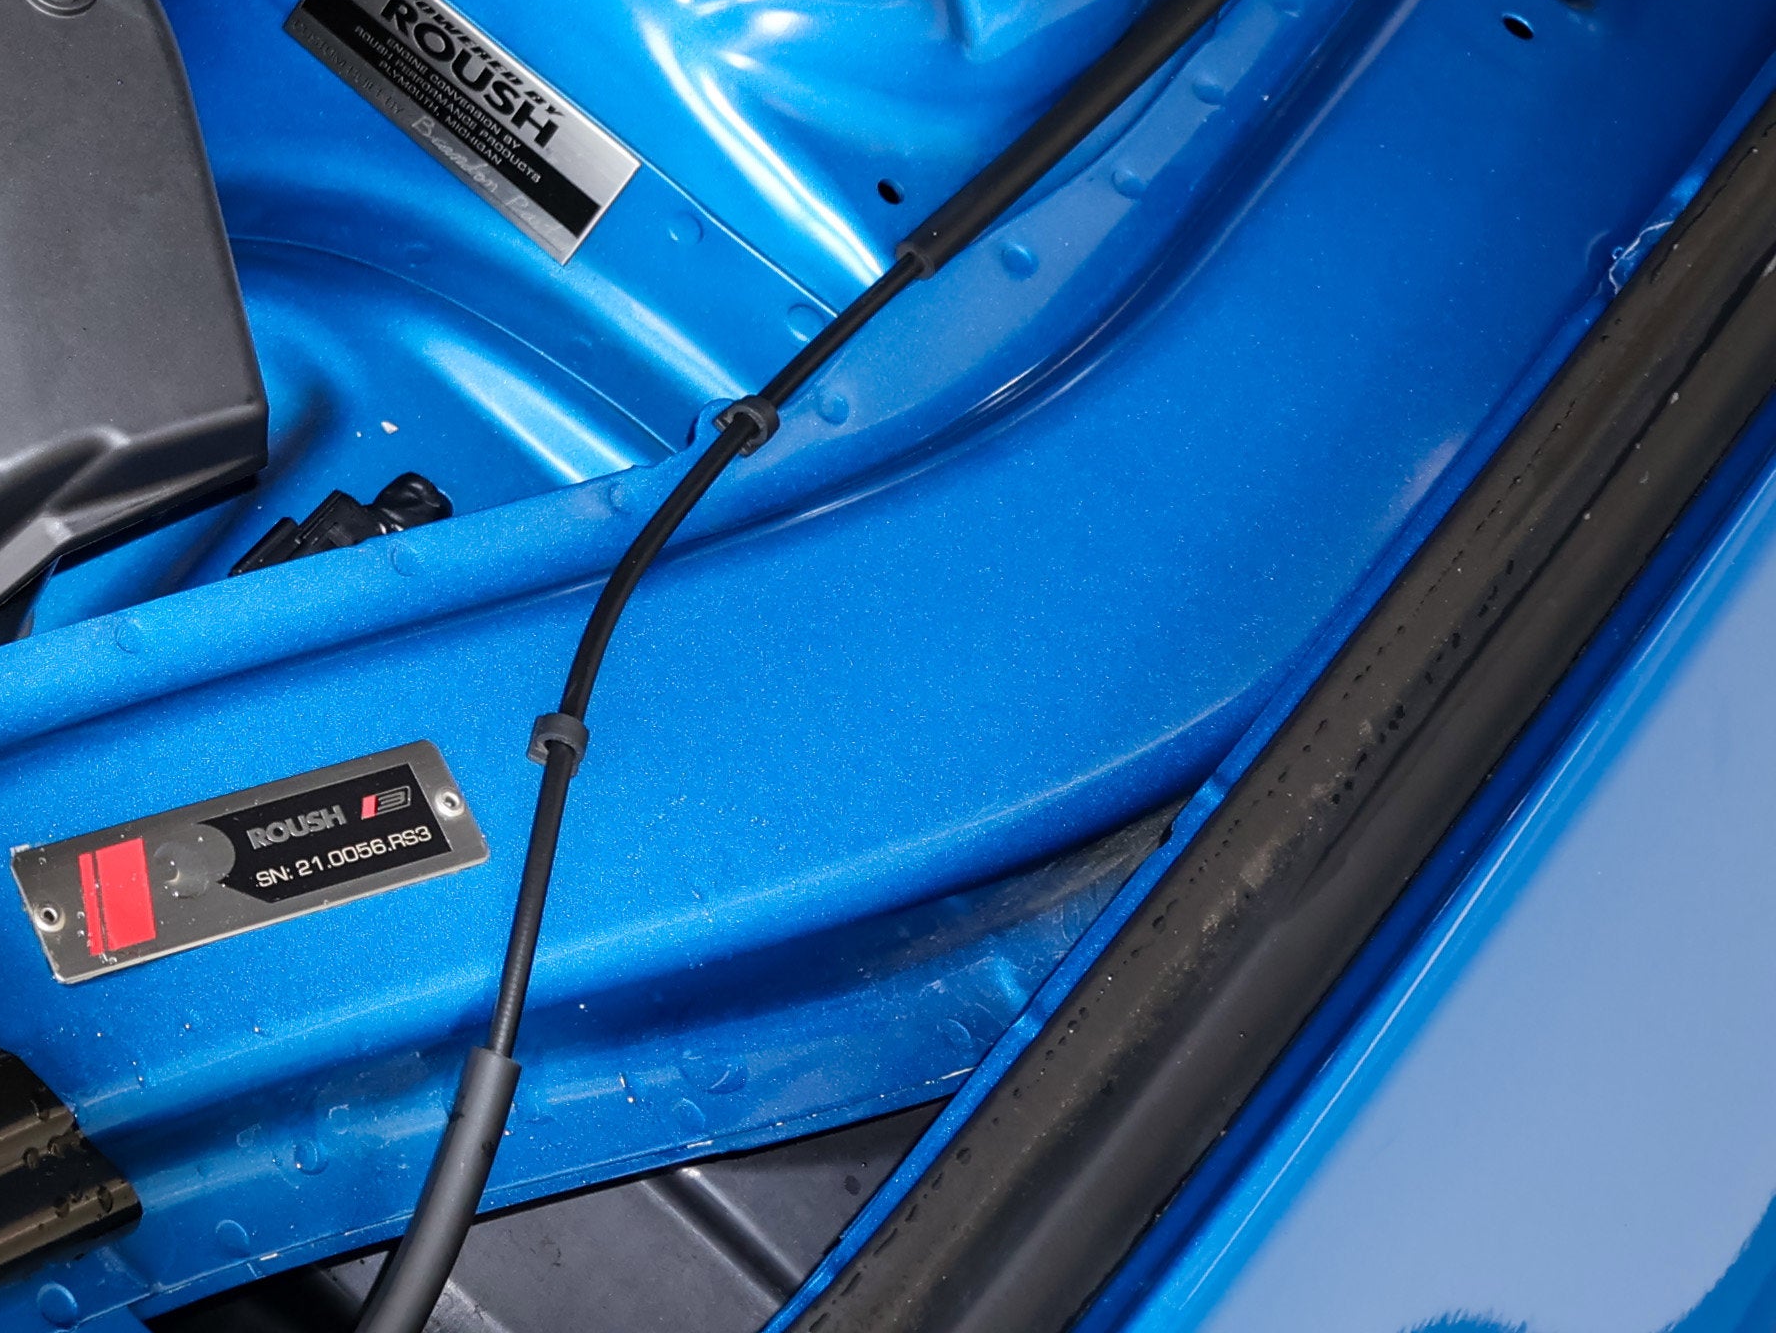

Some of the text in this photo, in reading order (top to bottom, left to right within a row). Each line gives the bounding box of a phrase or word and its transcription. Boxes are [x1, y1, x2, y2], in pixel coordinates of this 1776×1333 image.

[352, 25, 542, 184] ROUSH PERFORMANCE PRODUCTS
[376, 60, 503, 166] PLYMOUTH, MICHIGAN
[385, 38, 521, 151] ENGINE CONVERSION BY
[246, 804, 347, 850] ROUSH
[257, 825, 433, 887] SN: 21.0056.RS3
